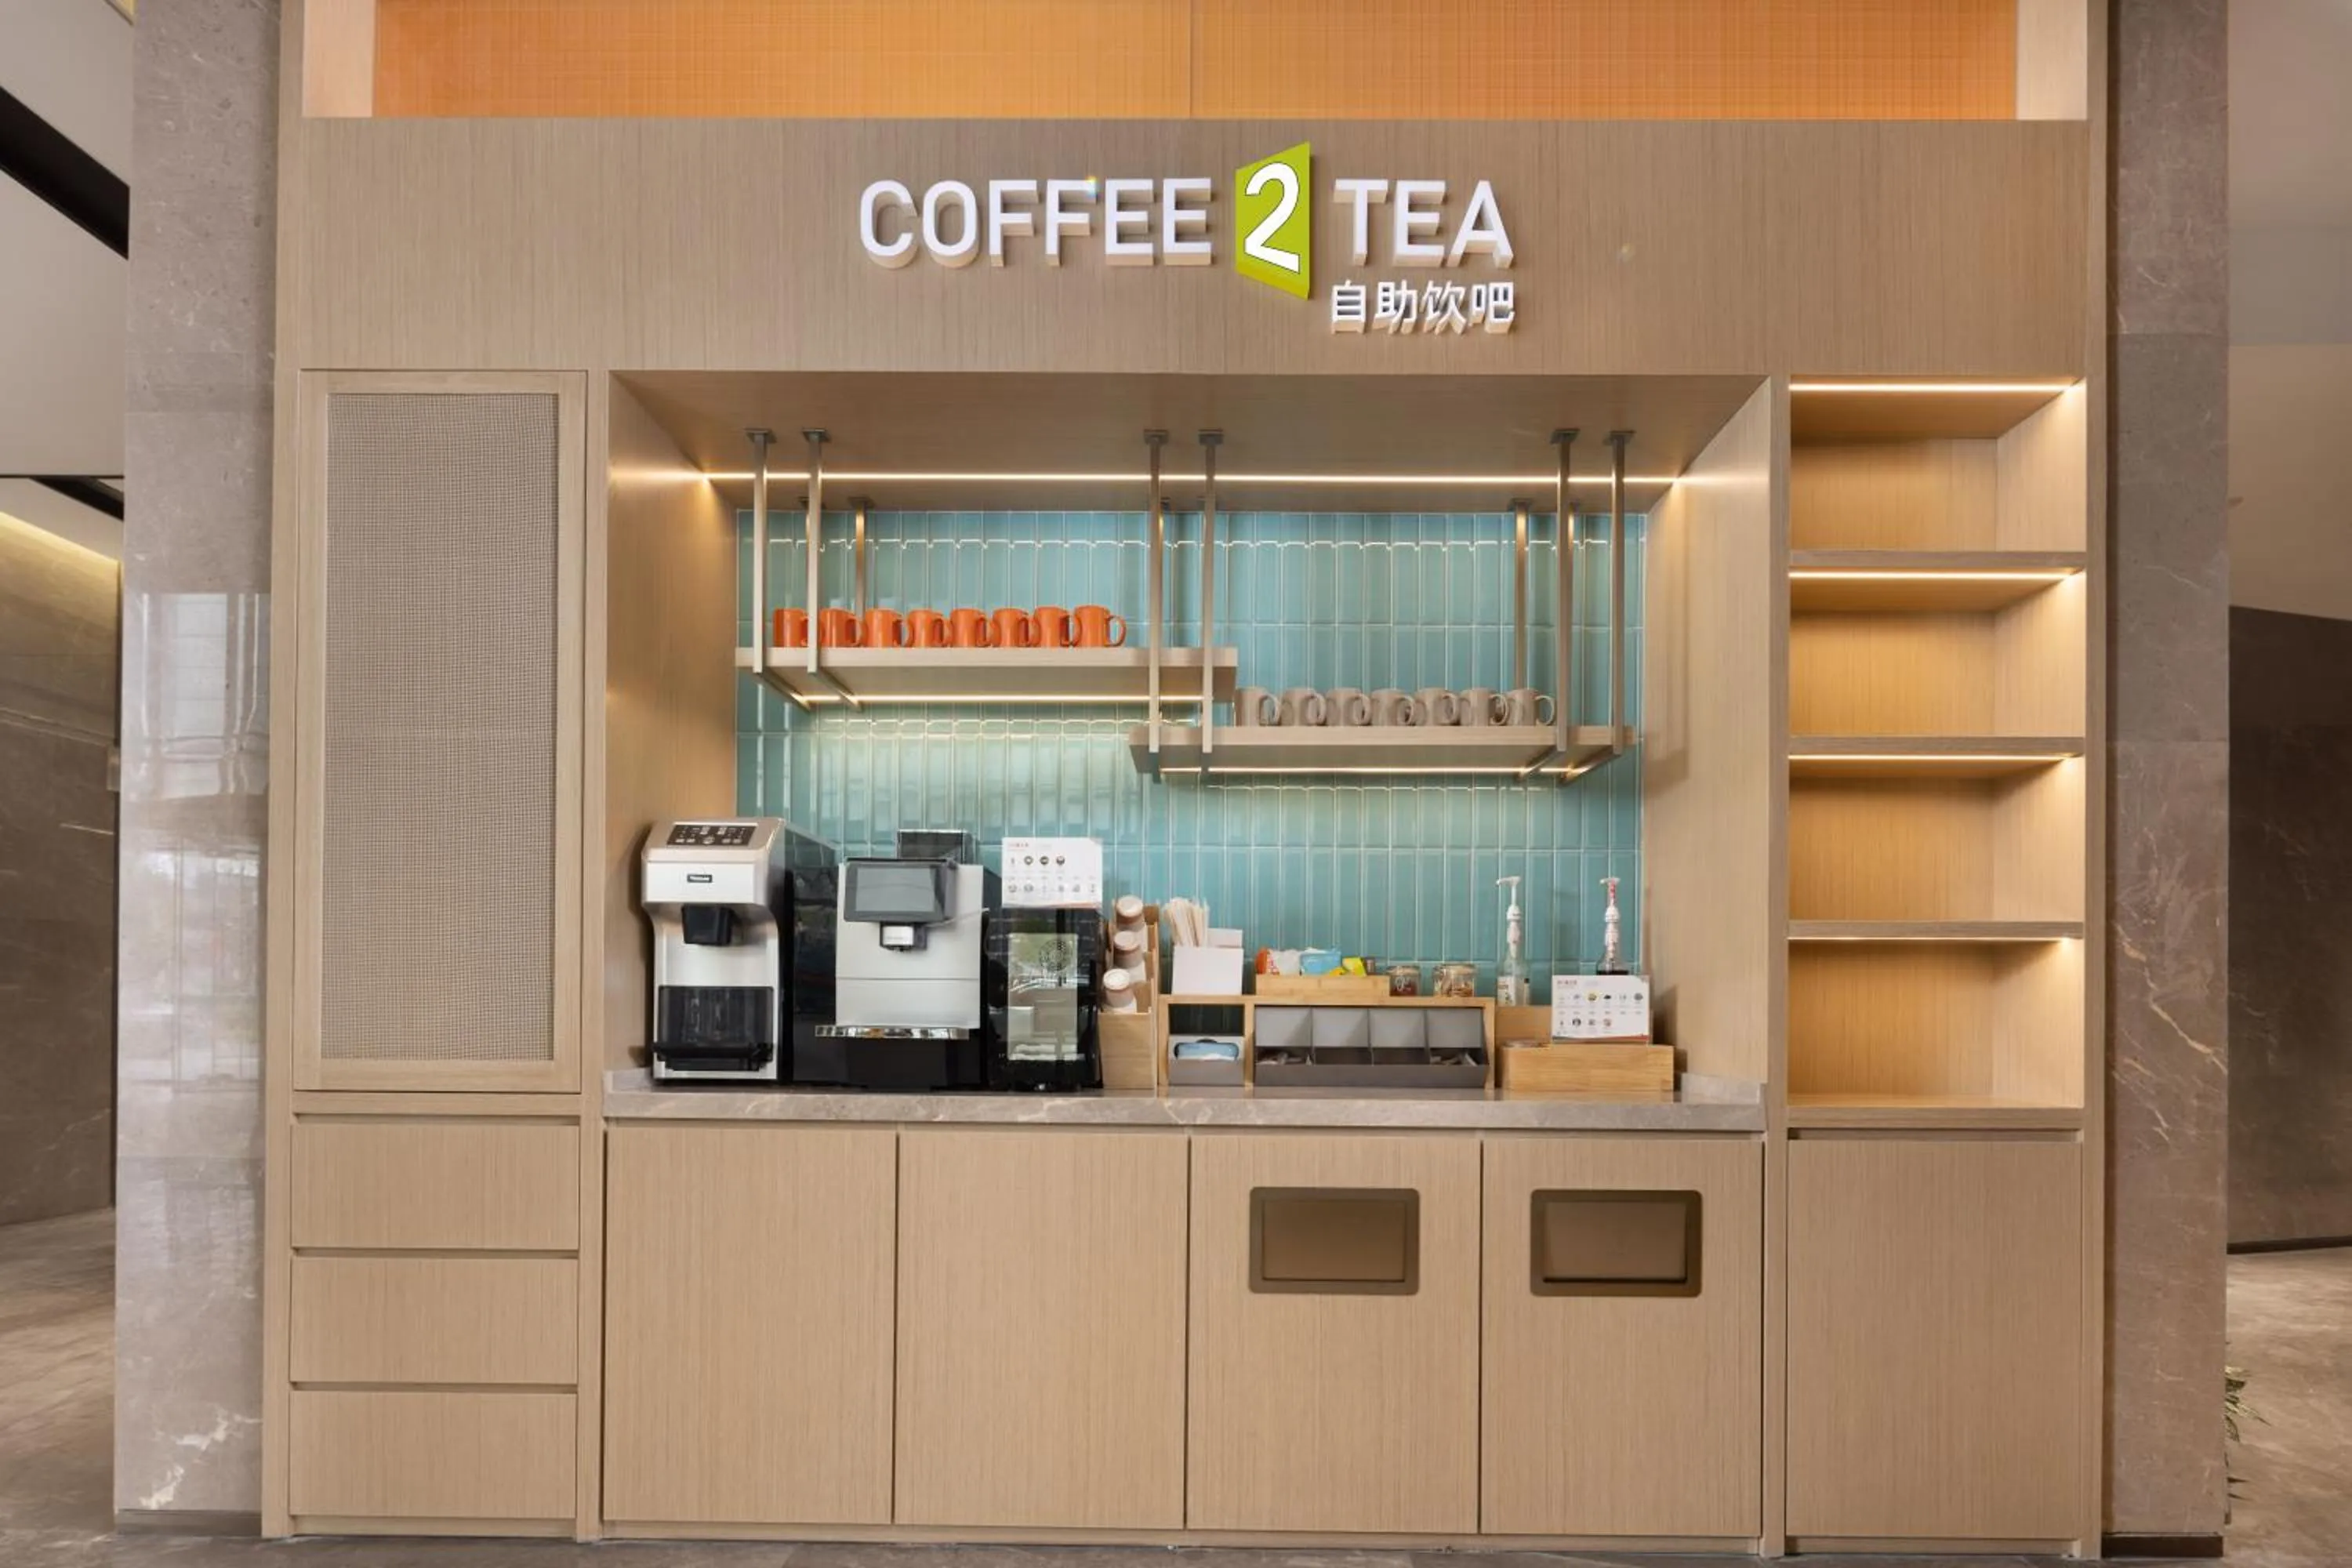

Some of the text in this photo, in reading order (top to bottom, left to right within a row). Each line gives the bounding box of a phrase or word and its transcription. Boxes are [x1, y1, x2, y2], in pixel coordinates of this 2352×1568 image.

[859, 162, 1515, 274] COFFEE 2 TEA
[1330, 281, 1515, 334] 自助饮吧
